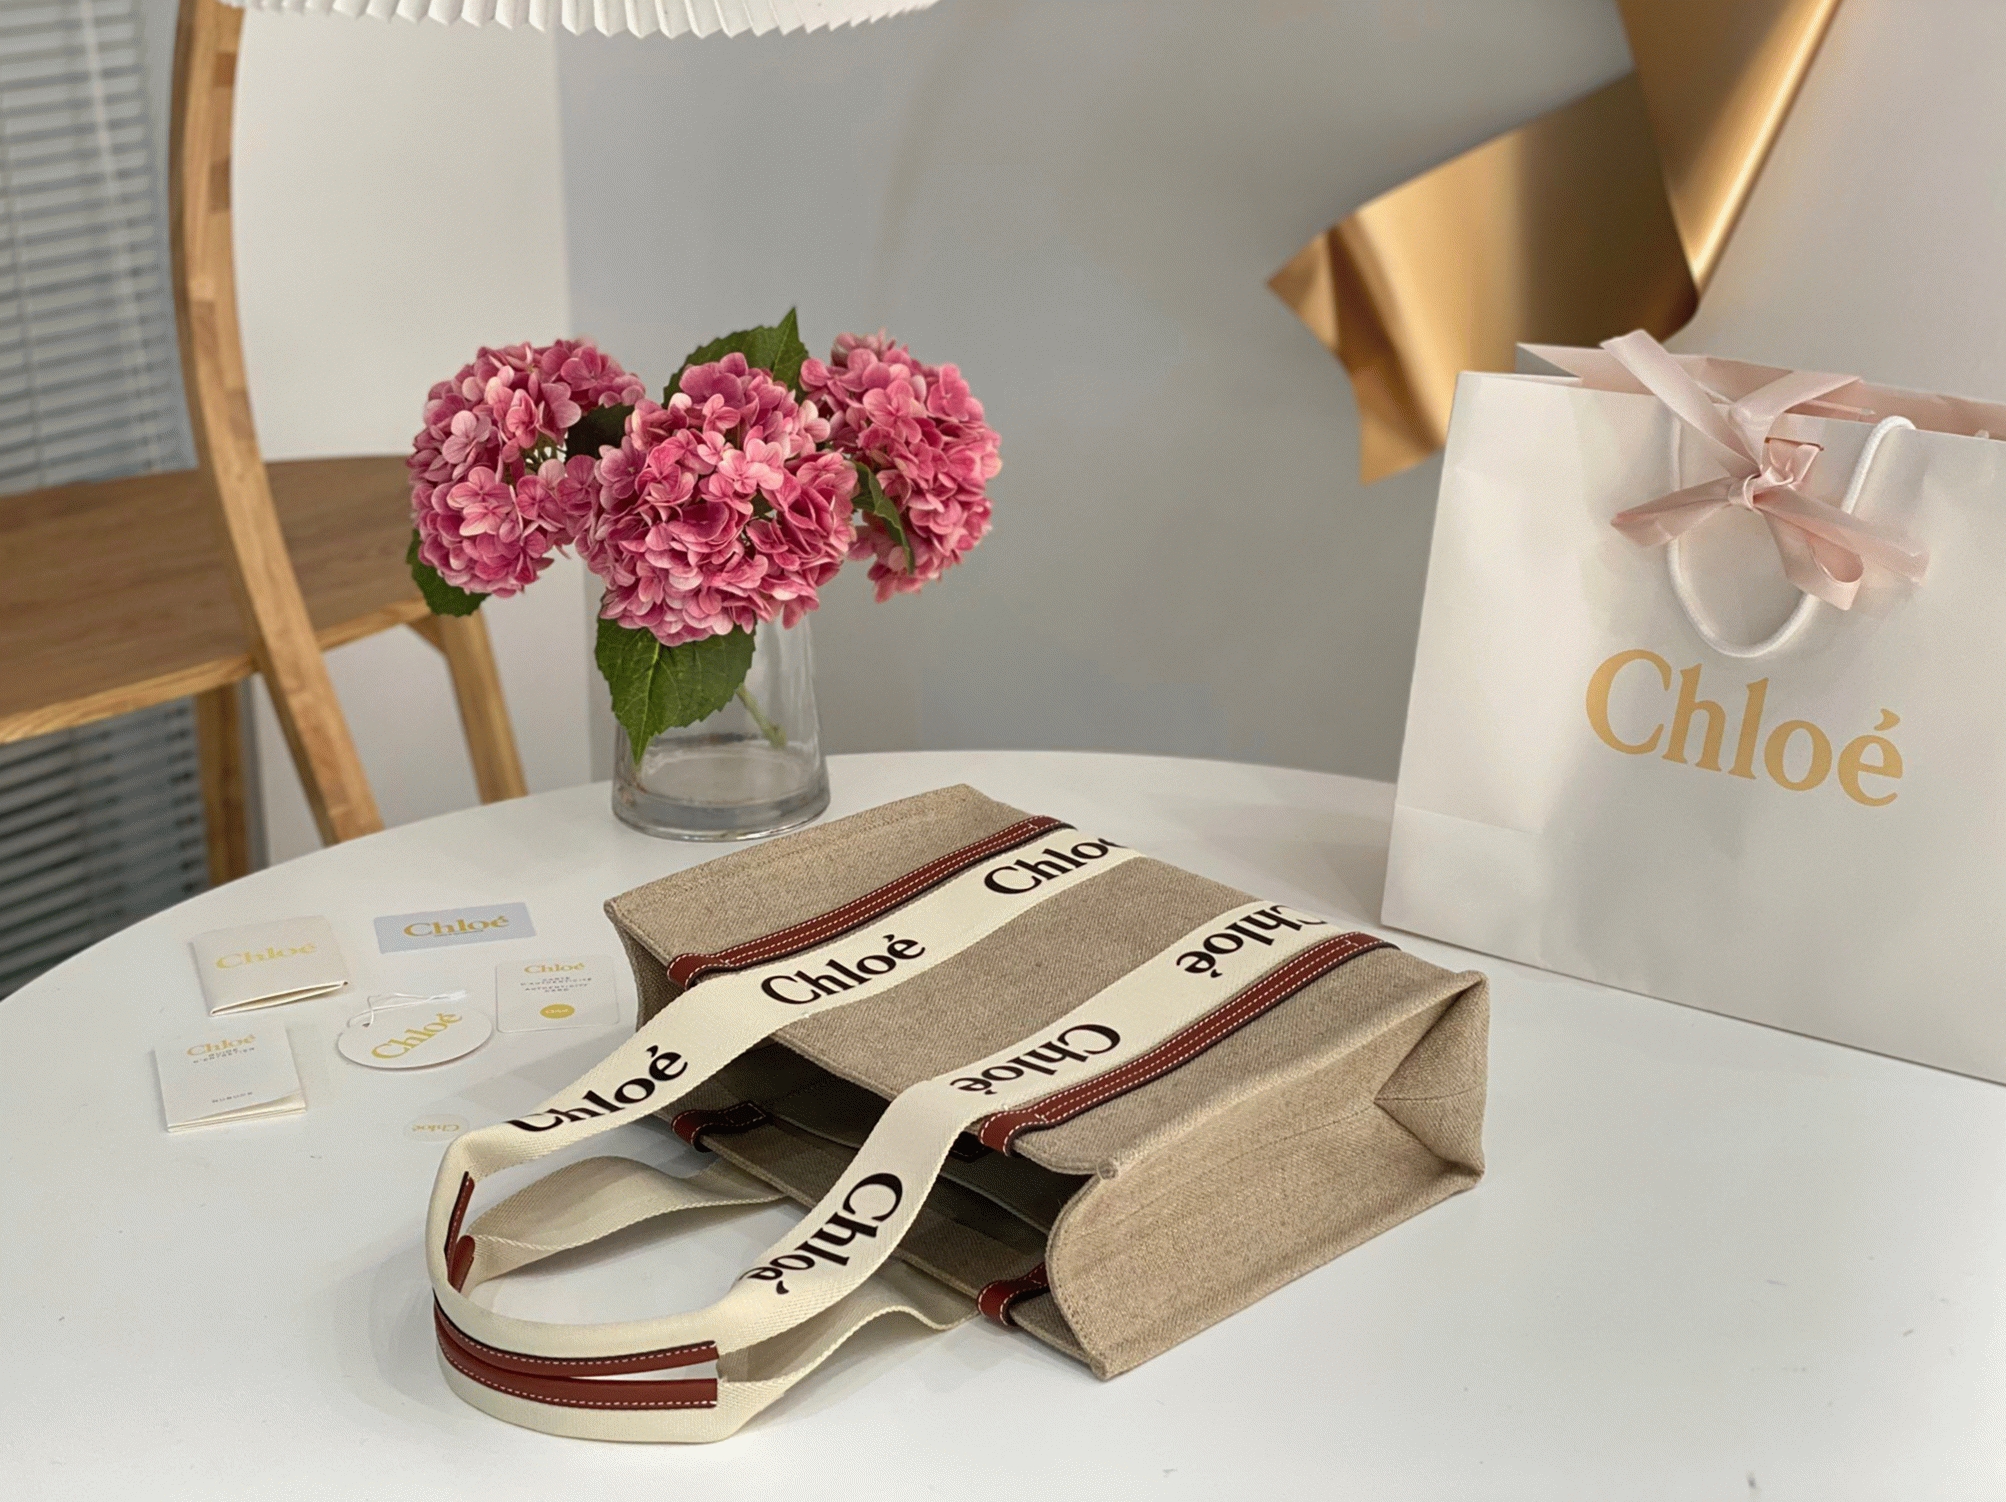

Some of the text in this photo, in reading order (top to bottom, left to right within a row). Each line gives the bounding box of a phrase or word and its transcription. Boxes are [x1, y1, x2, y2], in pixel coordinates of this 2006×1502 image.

[1586, 649, 1904, 807] Chloé
[984, 838, 1129, 895] Chlo
[404, 915, 509, 937] Chloé
[524, 962, 585, 974] Chloé
[761, 934, 926, 1005] Chloé
[371, 1012, 463, 1059] Chloé
[950, 1024, 1121, 1096] Chloé
[738, 1172, 903, 1295] Chloé
